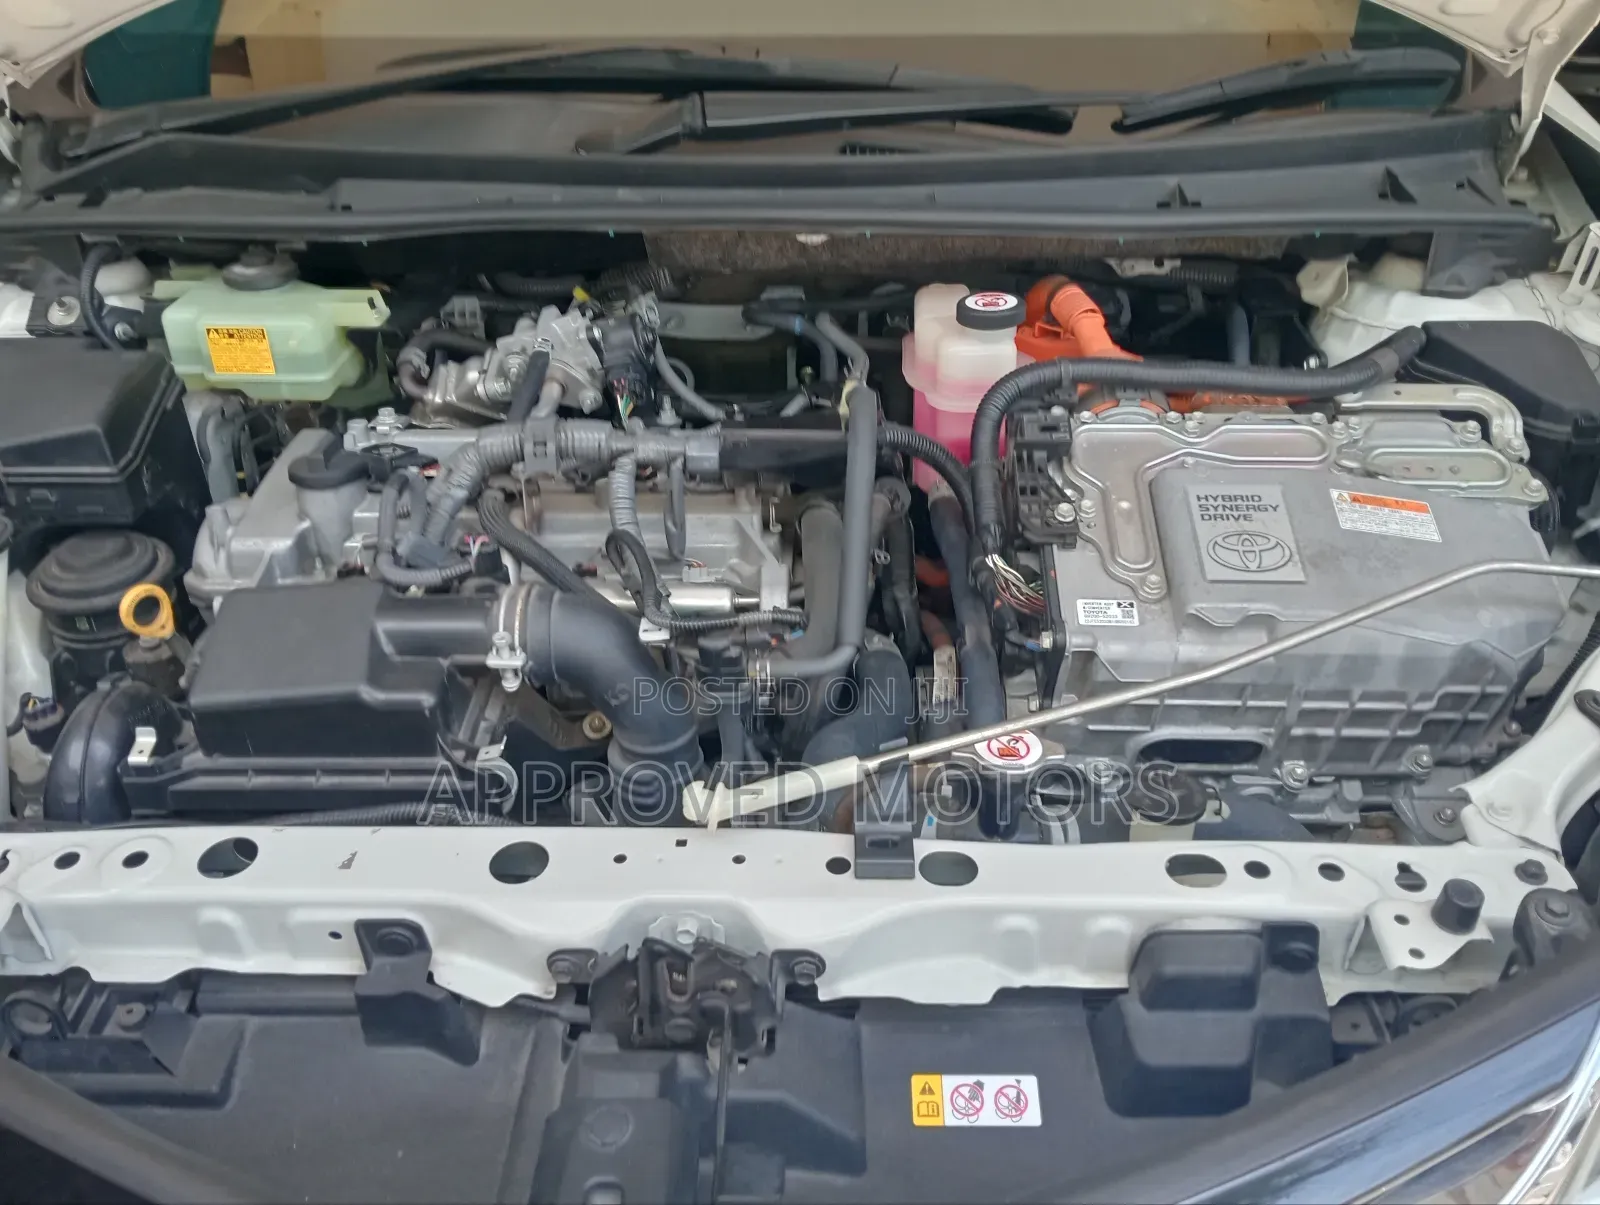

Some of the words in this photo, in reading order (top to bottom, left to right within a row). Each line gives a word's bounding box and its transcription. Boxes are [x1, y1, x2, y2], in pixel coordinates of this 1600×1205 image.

[1196, 494, 1262, 502] HYBRID
[1198, 504, 1280, 512] SYNERGY
[1200, 513, 1254, 522] DRIVE
